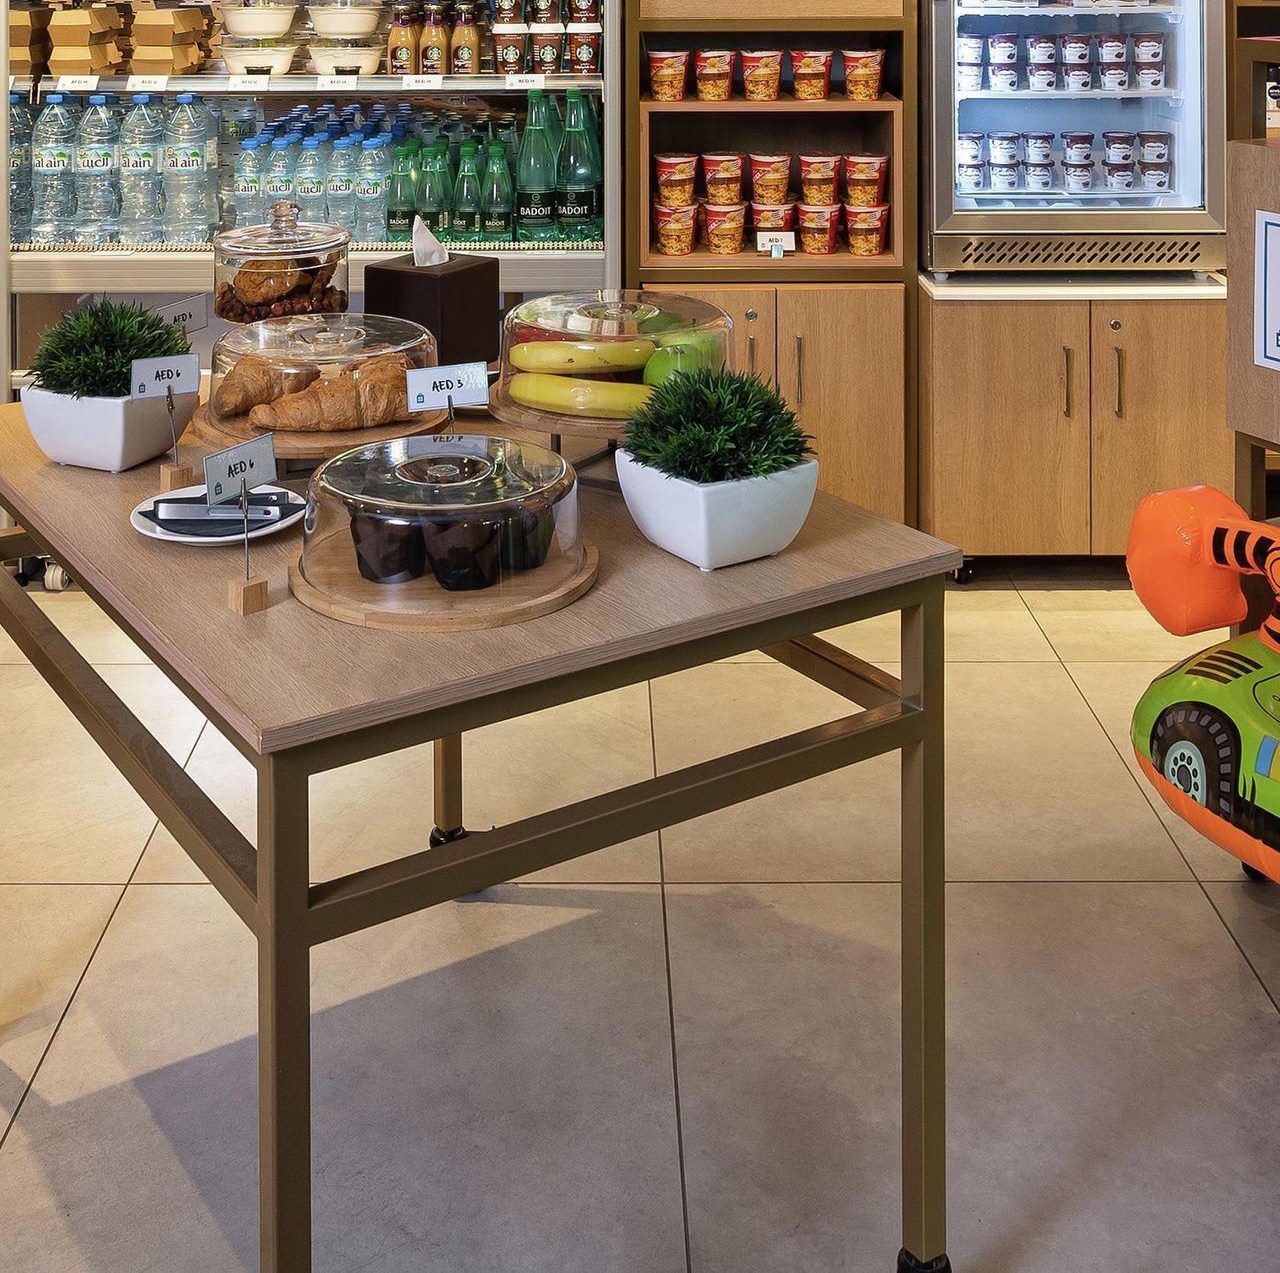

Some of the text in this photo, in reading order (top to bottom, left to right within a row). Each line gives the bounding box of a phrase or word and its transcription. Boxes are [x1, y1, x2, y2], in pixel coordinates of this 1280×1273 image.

[46, 157, 66, 168] ain
[132, 157, 151, 168] ain
[180, 157, 200, 168] ain
[520, 206, 551, 216] BADOIT
[557, 205, 588, 216] BADOIT
[155, 369, 175, 382] AED
[431, 379, 455, 392] AED
[227, 462, 248, 478] AED
